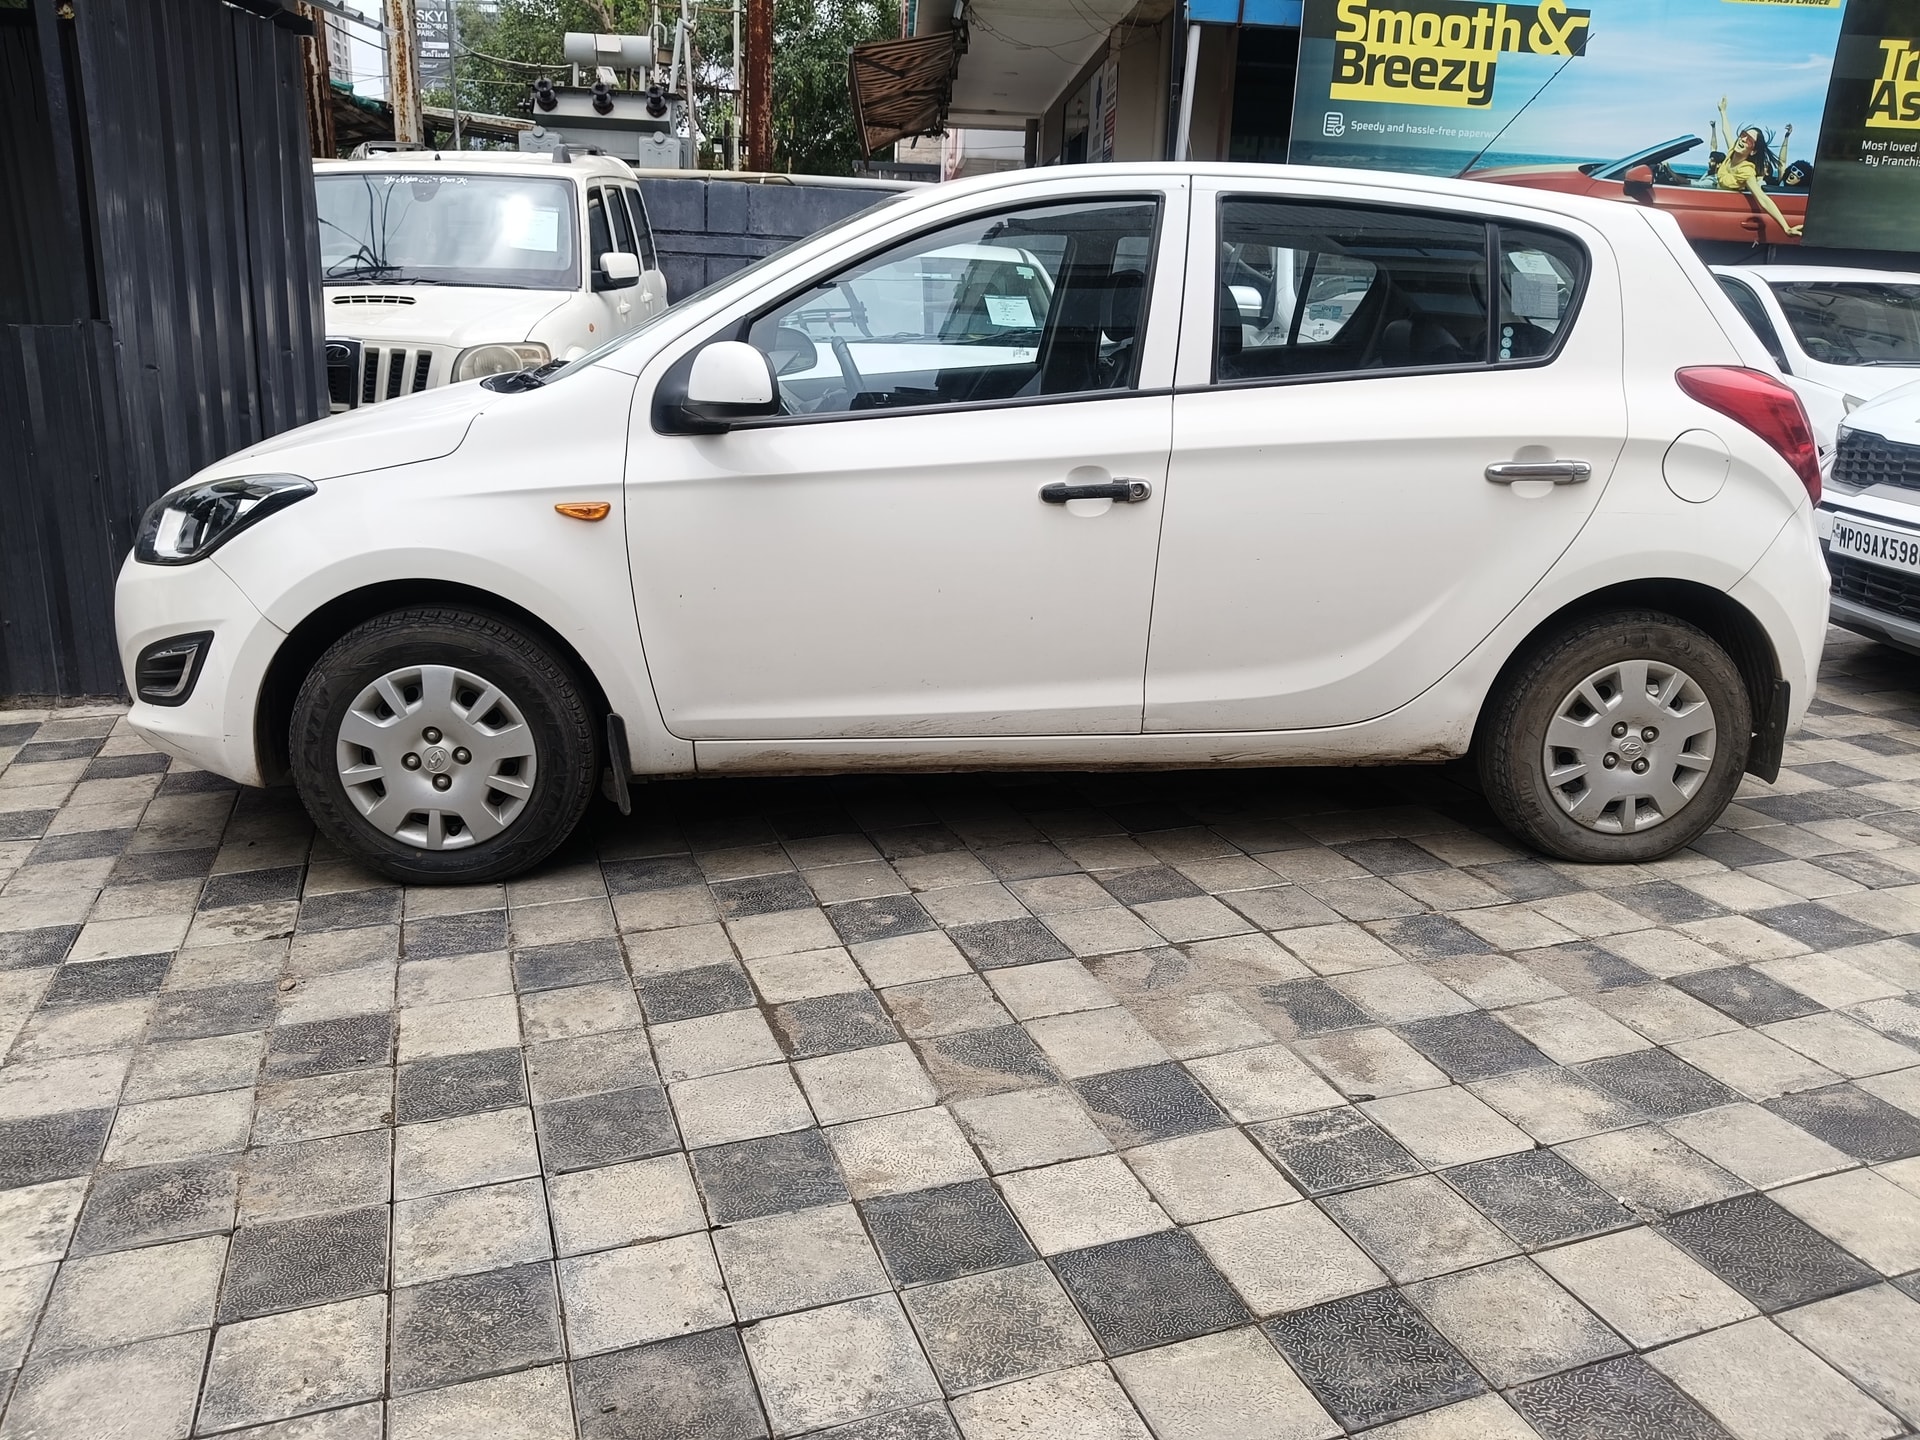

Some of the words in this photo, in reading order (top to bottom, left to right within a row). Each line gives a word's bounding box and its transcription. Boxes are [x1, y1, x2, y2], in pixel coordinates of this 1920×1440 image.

[1336, 0, 1522, 52] Smooth
[1528, 0, 1590, 56] &
[1332, 41, 1496, 106] Breezy
[1879, 39, 1920, 81] Tr
[1351, 120, 1385, 133] Speedy
[1386, 123, 1405, 132] and
[1406, 124, 1457, 136] hassle-free
[1862, 140, 1888, 151] Most
[1889, 141, 1918, 153] loved
[1865, 154, 1880, 168] By
[1839, 526, 1920, 565] MP09AX598
